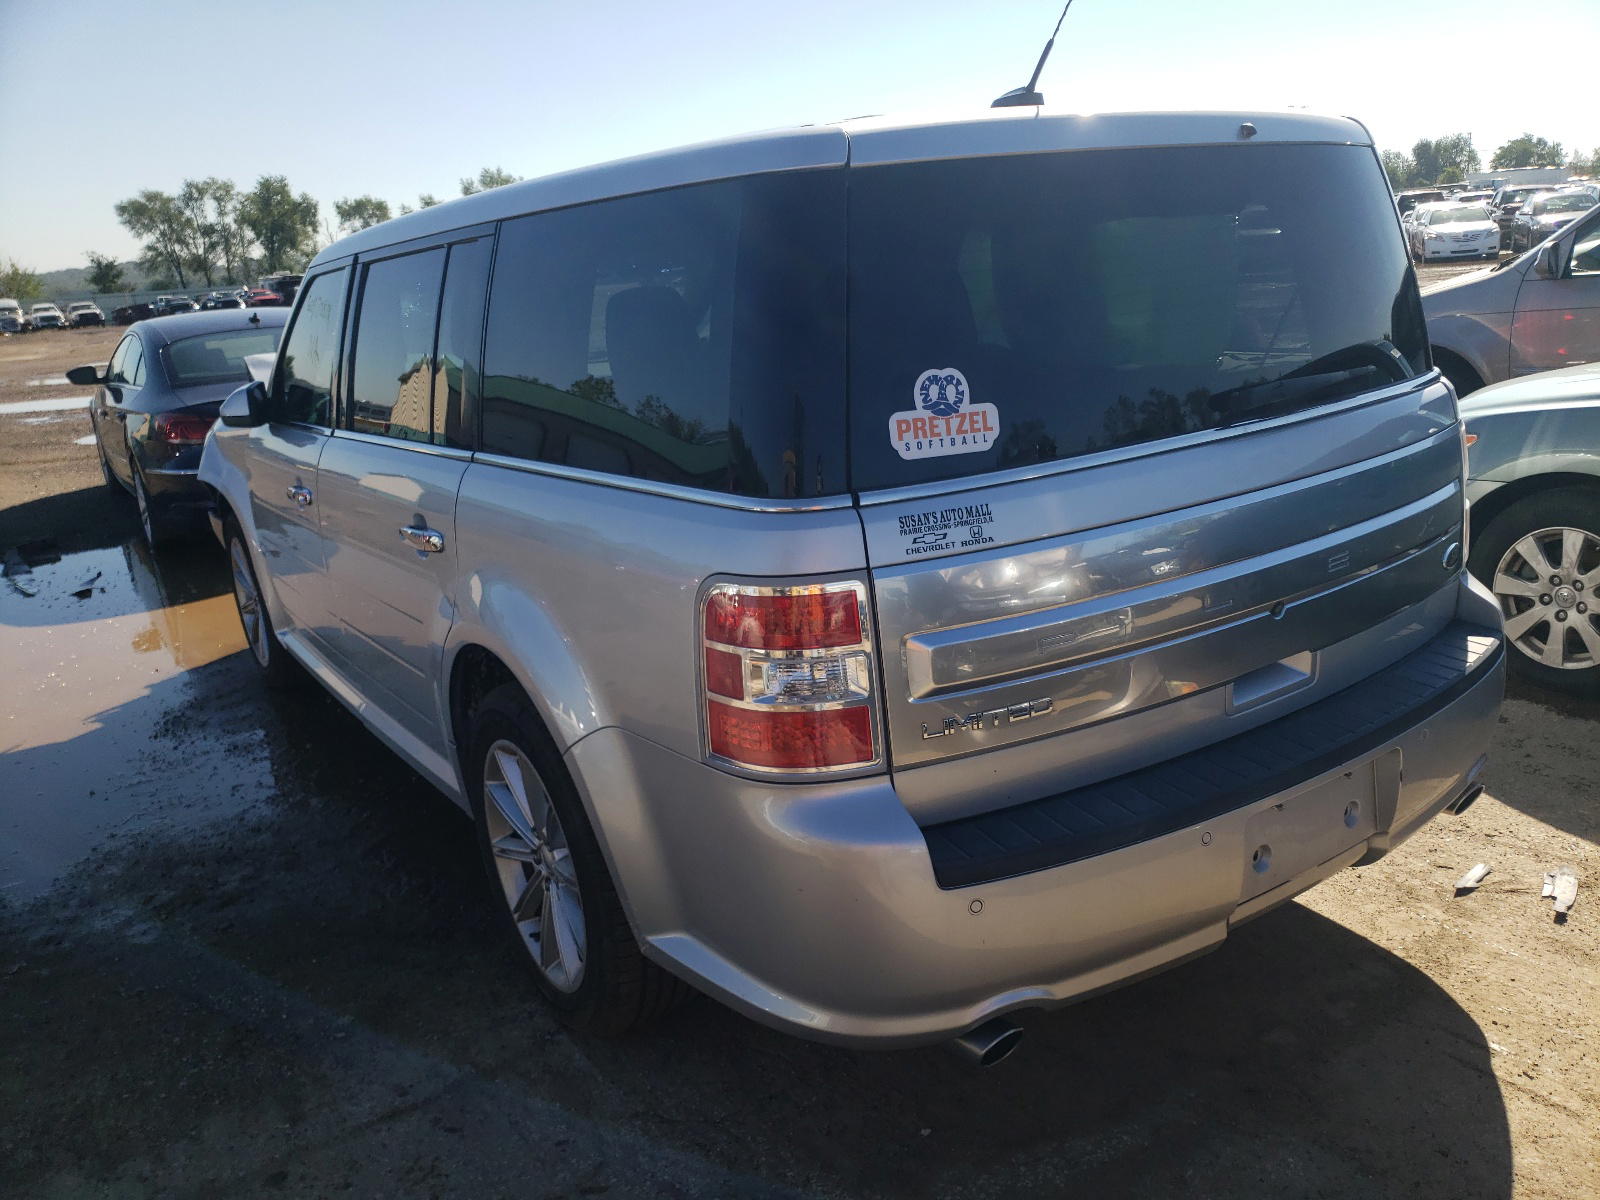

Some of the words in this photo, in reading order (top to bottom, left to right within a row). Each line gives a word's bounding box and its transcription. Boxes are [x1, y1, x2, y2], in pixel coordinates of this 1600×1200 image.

[920, 374, 943, 405] NEW
[896, 411, 993, 441] PRETZEL
[905, 434, 988, 451] SOFTBALL
[898, 512, 938, 529] SUSAN'S
[940, 508, 964, 523] AUTO
[965, 503, 992, 519] MALL
[924, 522, 952, 533] CROSSING
[906, 541, 956, 555] CHEVROLET
[961, 536, 994, 548] HONDA
[922, 697, 1053, 739] LIMITED
